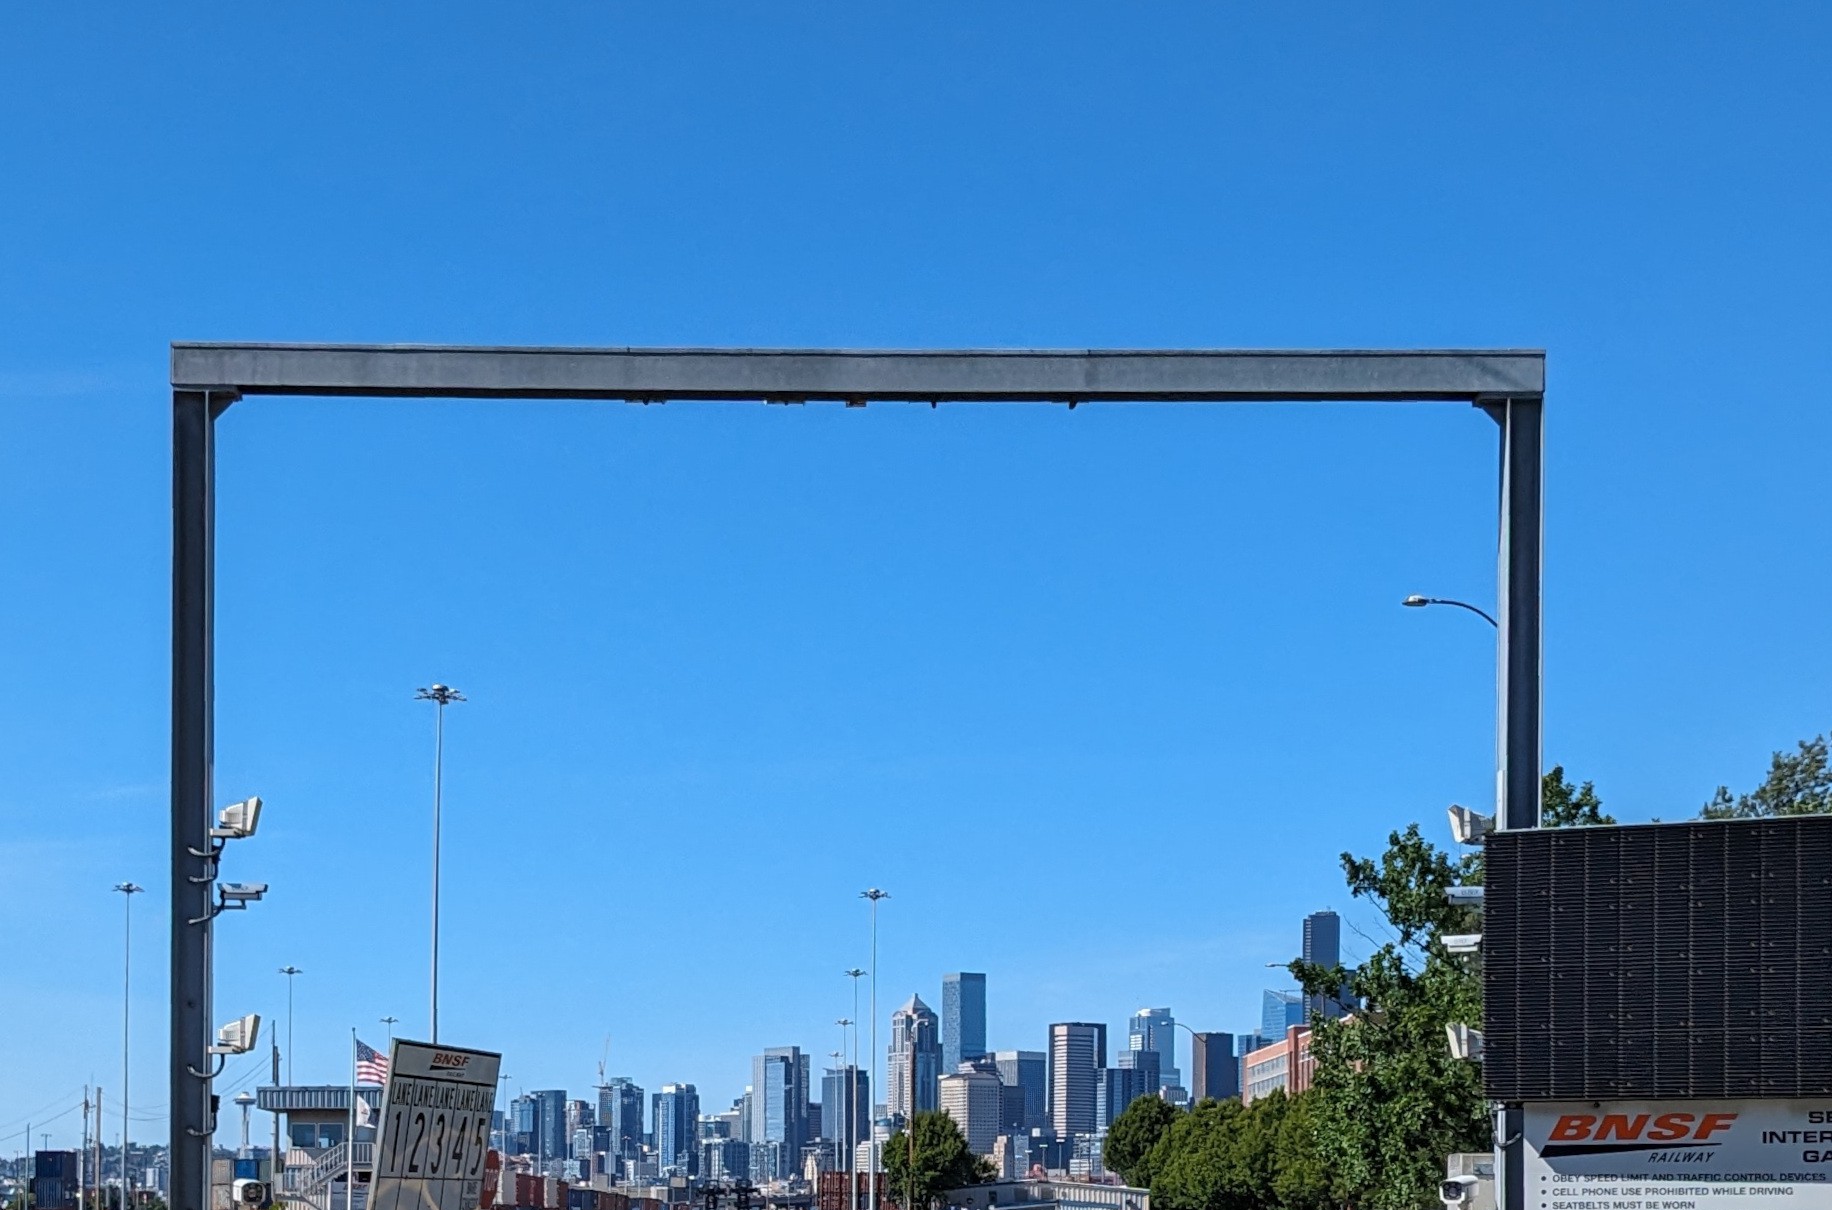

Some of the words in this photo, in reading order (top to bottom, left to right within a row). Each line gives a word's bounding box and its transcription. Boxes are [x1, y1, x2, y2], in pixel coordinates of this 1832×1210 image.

[432, 1052, 470, 1066] BNSF
[392, 1082, 412, 1106] LANE
[414, 1084, 434, 1108] LANE
[436, 1086, 455, 1110] LANE
[457, 1088, 476, 1111] LANE
[476, 1091, 494, 1113] LANE
[1548, 1113, 1739, 1141] BNSF
[390, 1112, 402, 1172] 1
[408, 1113, 426, 1173] 2
[430, 1114, 445, 1174] 3
[452, 1116, 466, 1175] 4
[470, 1118, 486, 1176] 5
[1762, 1131, 1832, 1144] INTER
[1648, 1152, 1716, 1163] RAILWAY
[1553, 1173, 1582, 1182] OBEY
[1585, 1174, 1618, 1183] SPEED
[1622, 1173, 1649, 1182] LIMIT
[1651, 1172, 1674, 1181] AND
[1677, 1173, 1721, 1182] TRAFFIC
[1724, 1173, 1777, 1182] CONTROL
[1780, 1173, 1826, 1182] DEVICES
[1553, 1187, 1579, 1196] CELL
[1582, 1187, 1618, 1196] PHONE
[1622, 1187, 1642, 1196] USE
[1645, 1187, 1710, 1196] PROHIBITED
[1713, 1187, 1746, 1196] WHILE
[1750, 1186, 1794, 1195] DRIVING
[1553, 1201, 1610, 1210] SEATBELTS
[1613, 1201, 1643, 1210] MUST
[1646, 1201, 1660, 1210] BE
[1663, 1201, 1696, 1210] WORN
